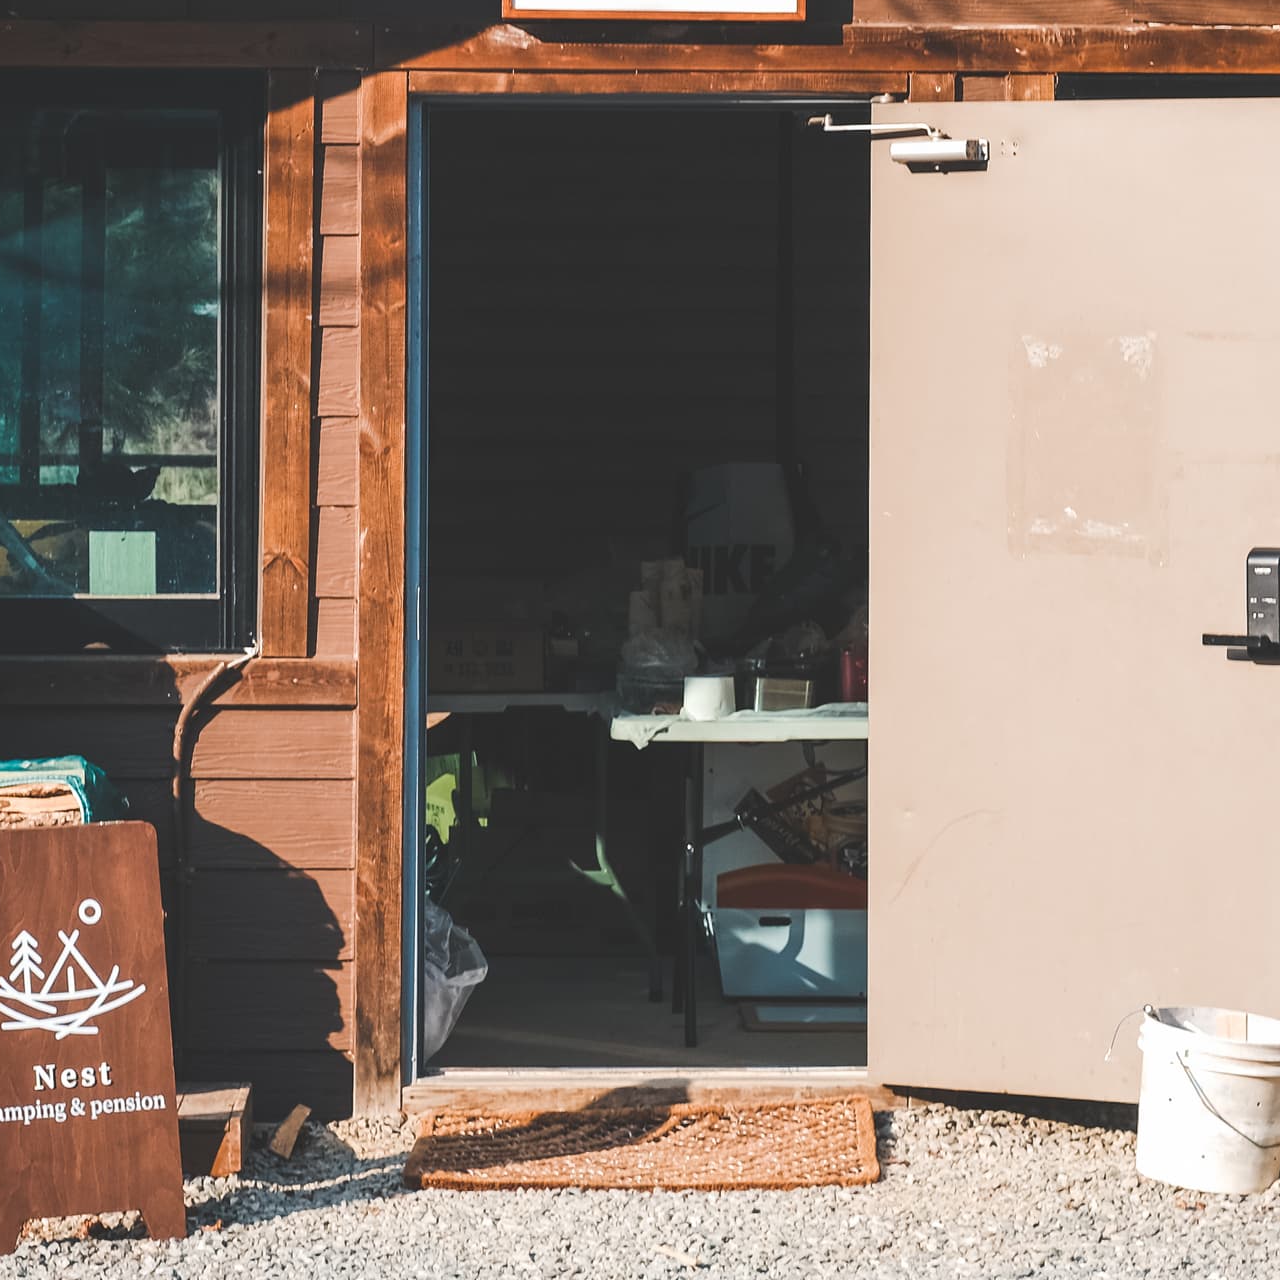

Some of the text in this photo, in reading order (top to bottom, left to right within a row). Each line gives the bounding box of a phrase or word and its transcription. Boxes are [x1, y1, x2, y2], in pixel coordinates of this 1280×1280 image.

[33, 1061, 112, 1091] Nest
[70, 1097, 86, 1117] &
[90, 1091, 166, 1120] pension
